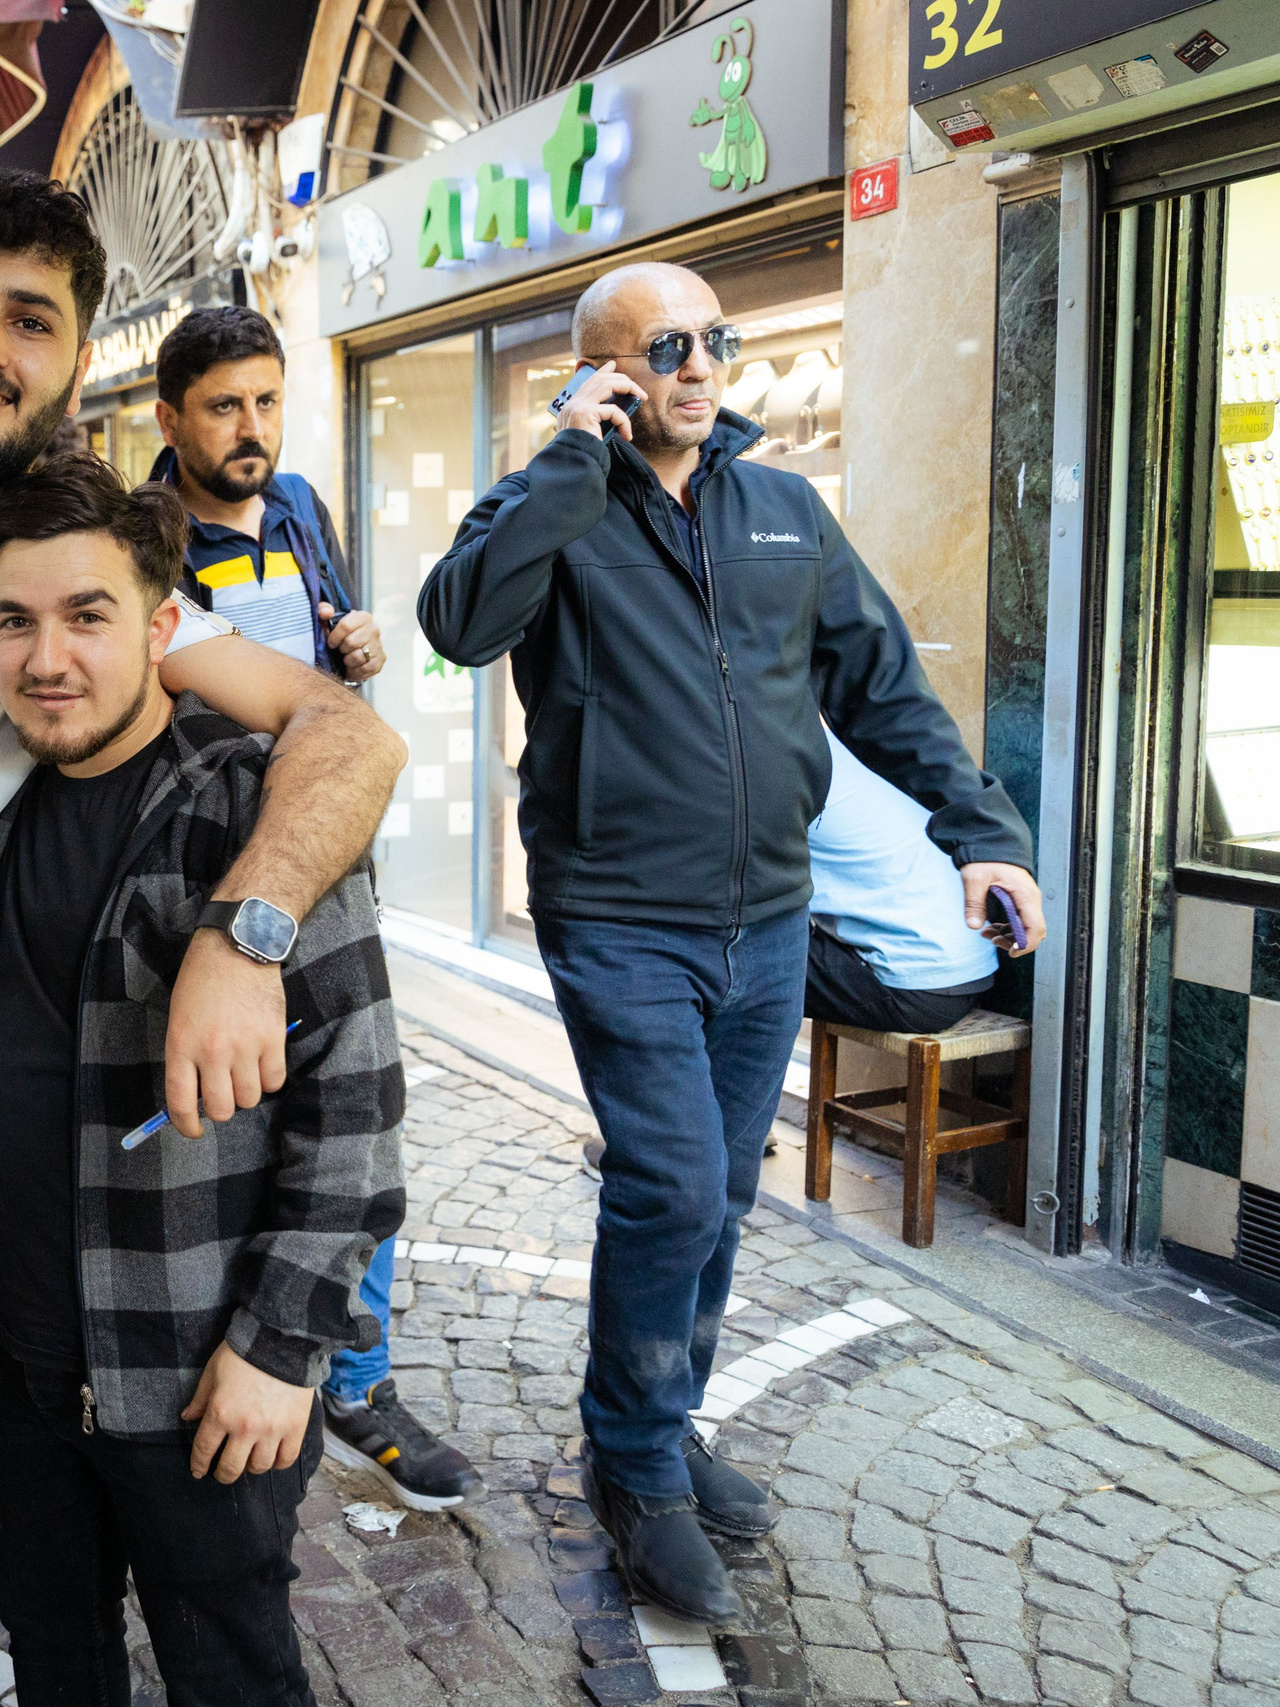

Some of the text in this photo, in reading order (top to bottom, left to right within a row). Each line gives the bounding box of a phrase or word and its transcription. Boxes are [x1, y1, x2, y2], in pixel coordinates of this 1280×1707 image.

[923, 0, 1002, 70] 32
[861, 175, 884, 205] 34
[759, 533, 800, 542] Columbia
